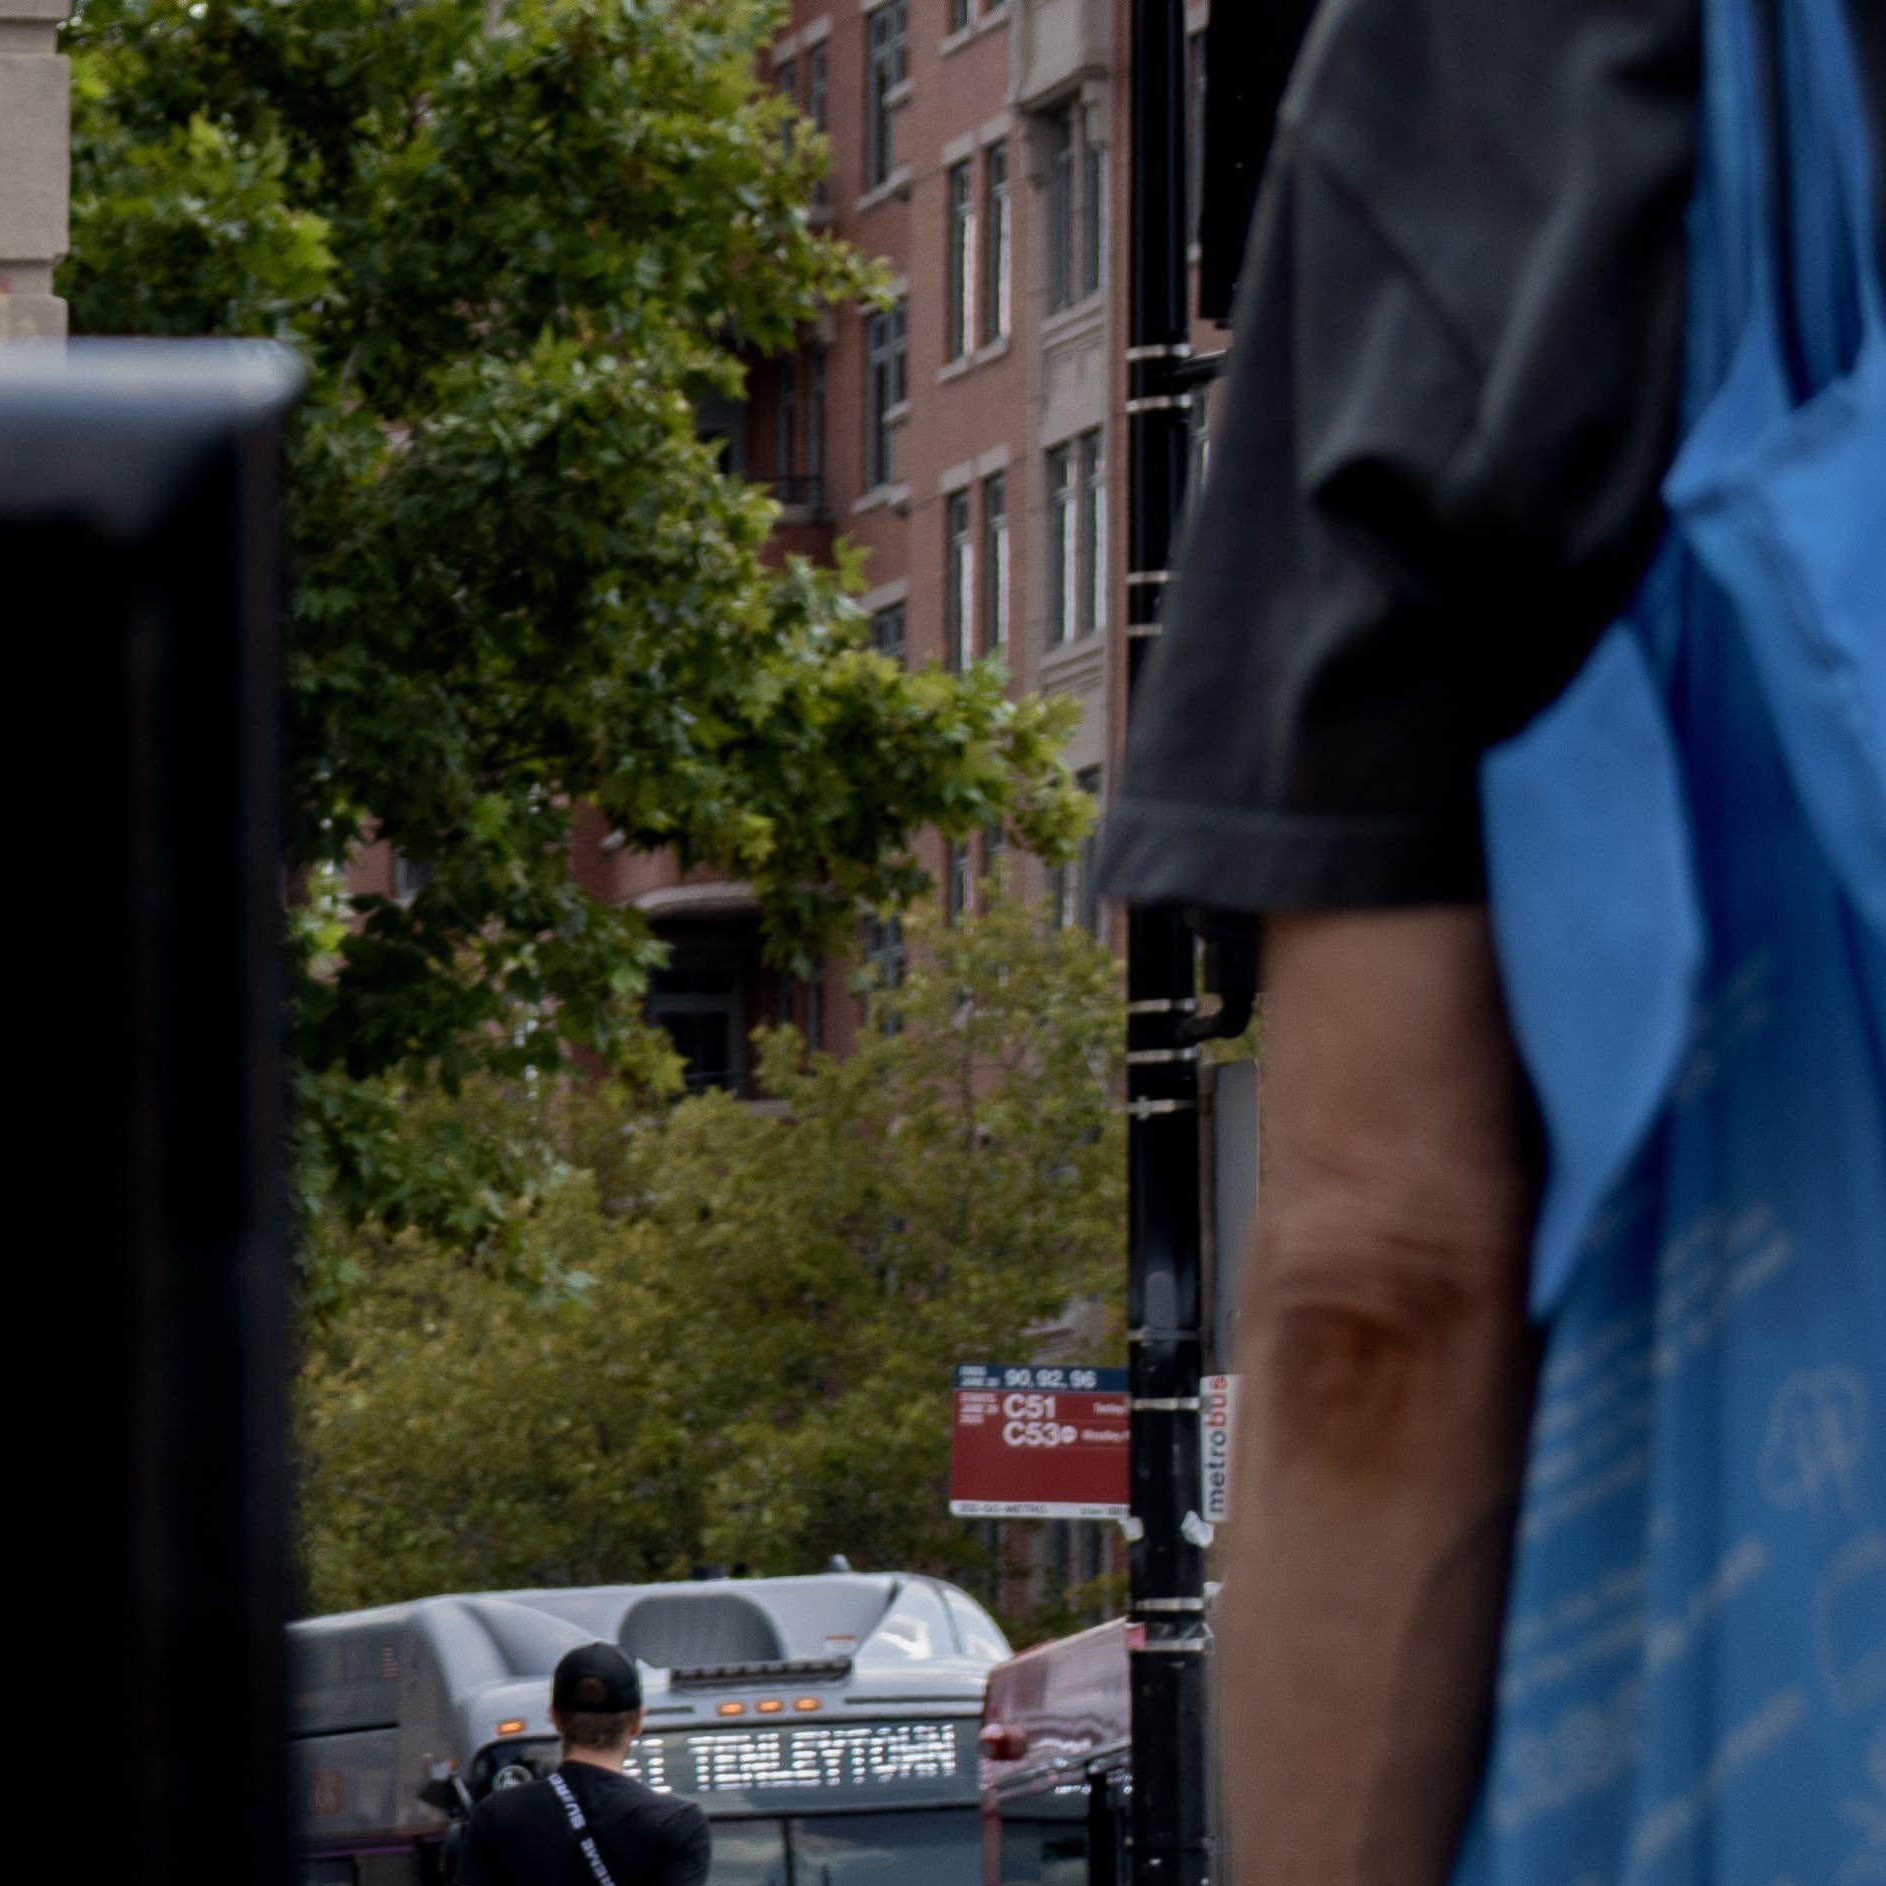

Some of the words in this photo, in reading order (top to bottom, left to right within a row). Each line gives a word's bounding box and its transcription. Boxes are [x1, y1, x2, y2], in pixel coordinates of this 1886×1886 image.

[1003, 1393, 1056, 1419] C51
[1003, 1421, 1060, 1446] C53
[1206, 1376, 1227, 1514] metrobus
[687, 1722, 957, 1792] TENLEYTOWN
